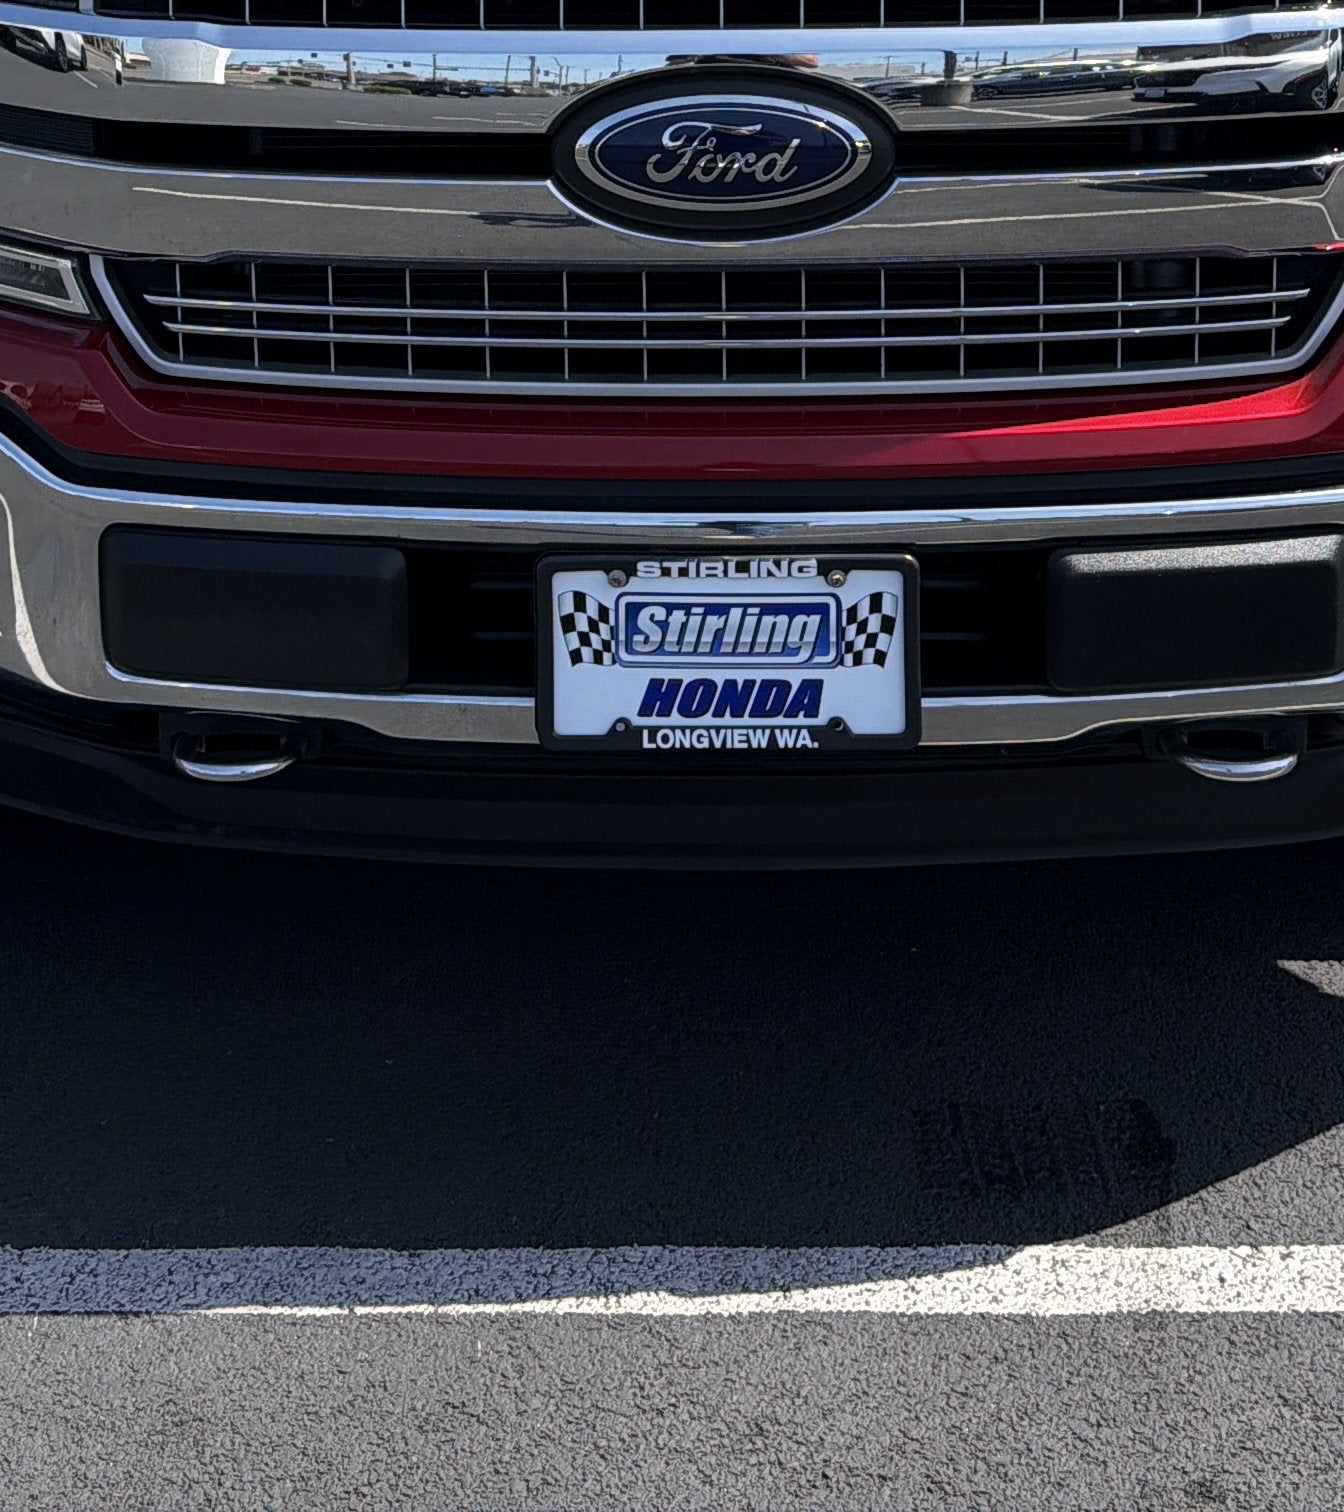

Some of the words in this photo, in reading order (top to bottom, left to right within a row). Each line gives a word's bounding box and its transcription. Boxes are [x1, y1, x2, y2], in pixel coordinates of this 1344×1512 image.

[645, 121, 802, 184] Ford
[636, 557, 819, 579] STIRLING
[631, 605, 822, 663] Stirling
[637, 678, 824, 719] HONDA
[642, 728, 772, 750] LONGVIEW
[776, 729, 819, 750] WA.
